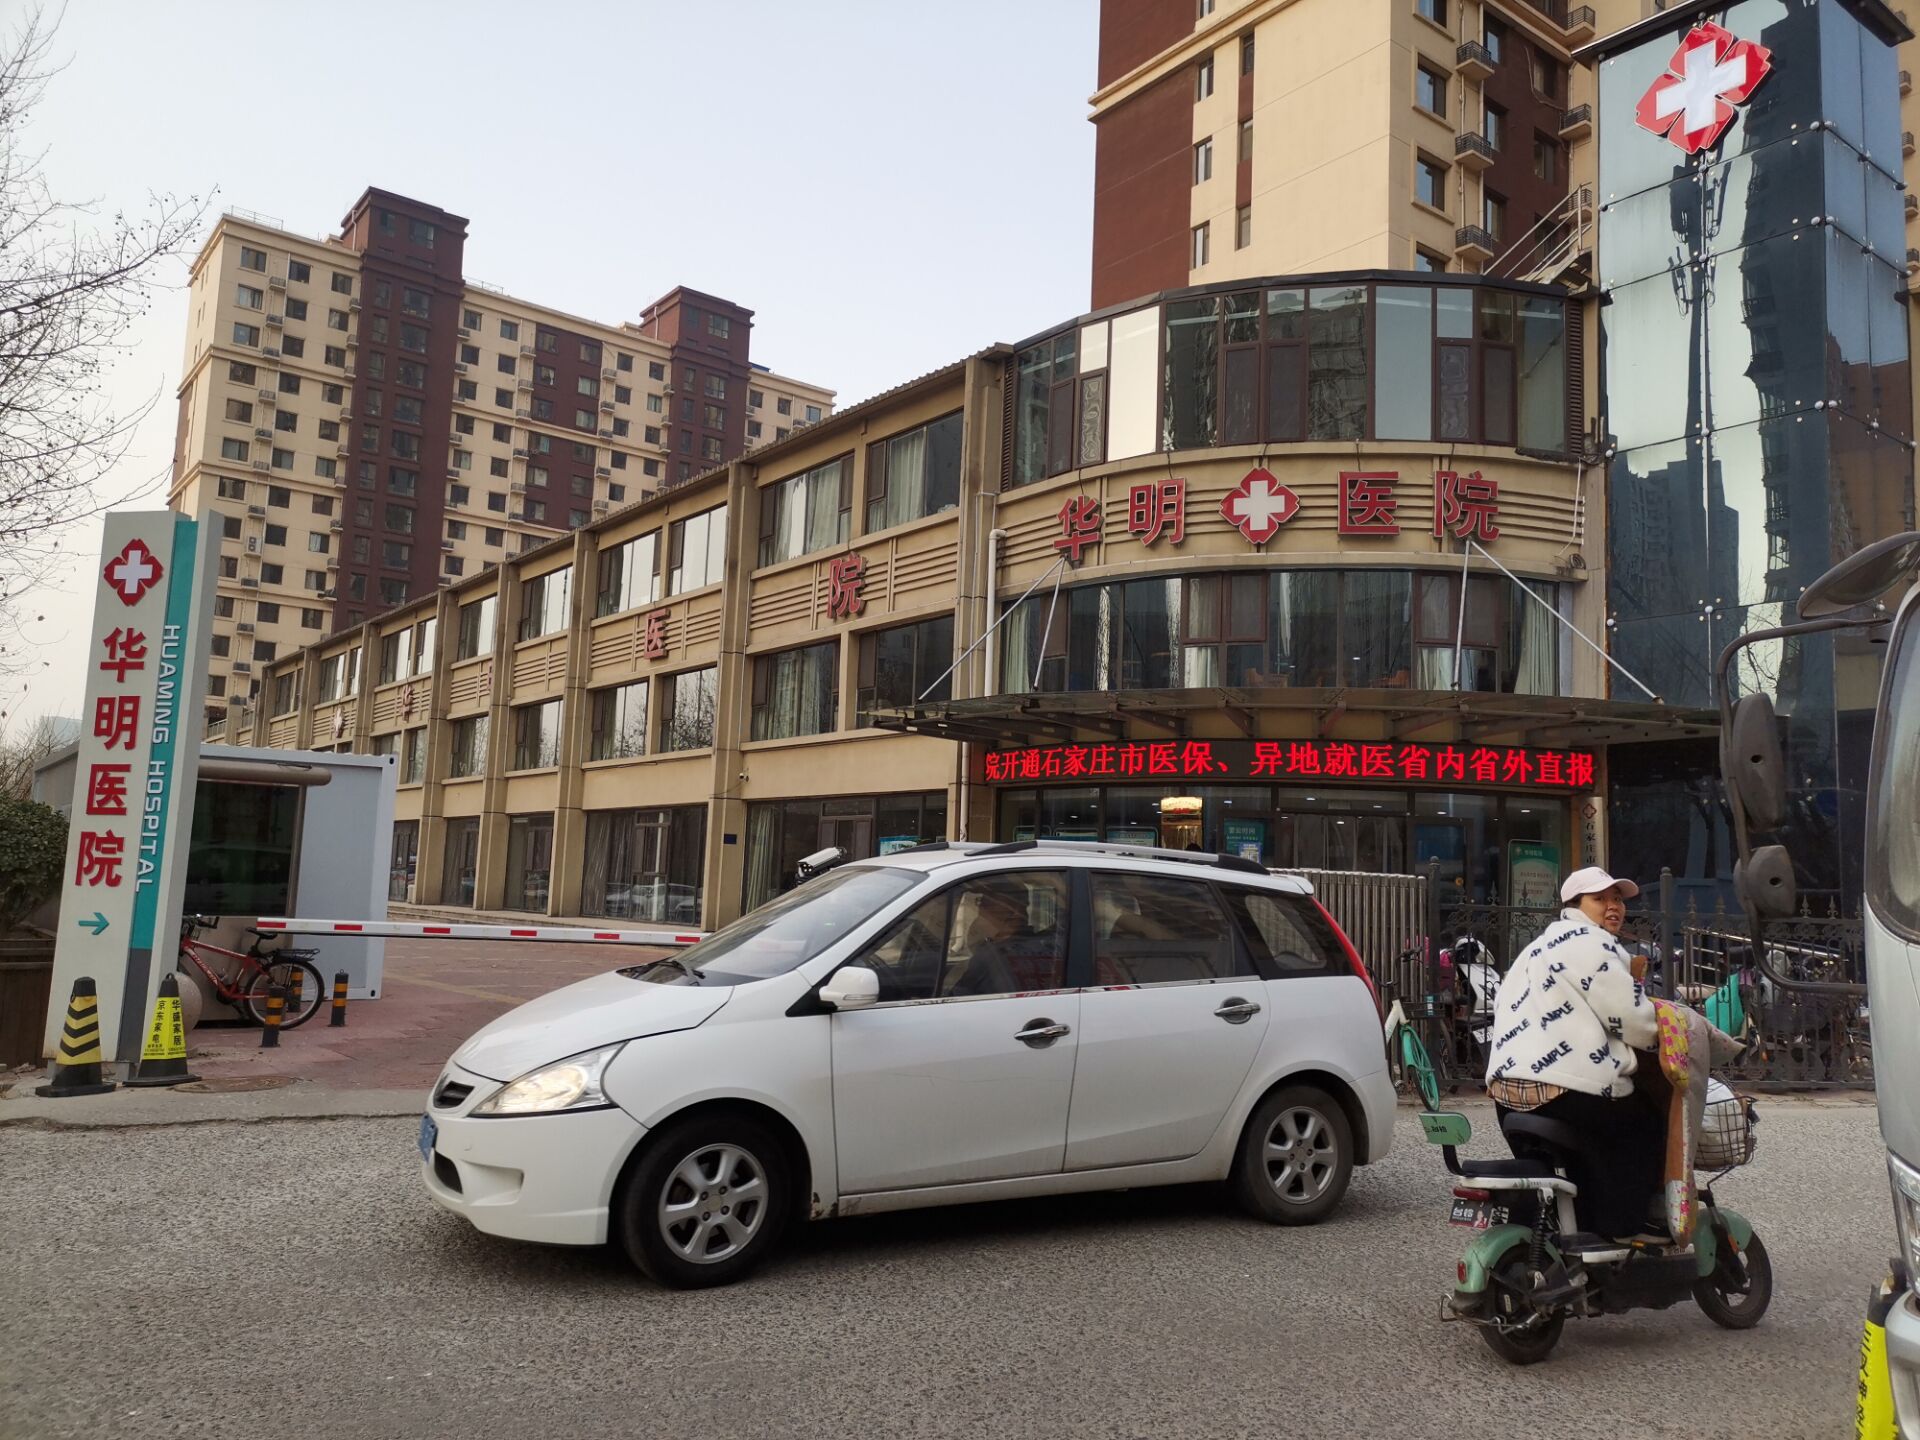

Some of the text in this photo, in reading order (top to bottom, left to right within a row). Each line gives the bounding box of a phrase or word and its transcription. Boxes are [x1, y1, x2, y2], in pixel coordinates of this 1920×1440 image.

[75, 626, 149, 888] 华明医院
[135, 624, 181, 893] HUAMING HOSPITAL
[1547, 926, 1590, 949] SAMPLE
[1495, 1018, 1531, 1050] SAMPLE
[1531, 1040, 1573, 1074] SAMPLE
